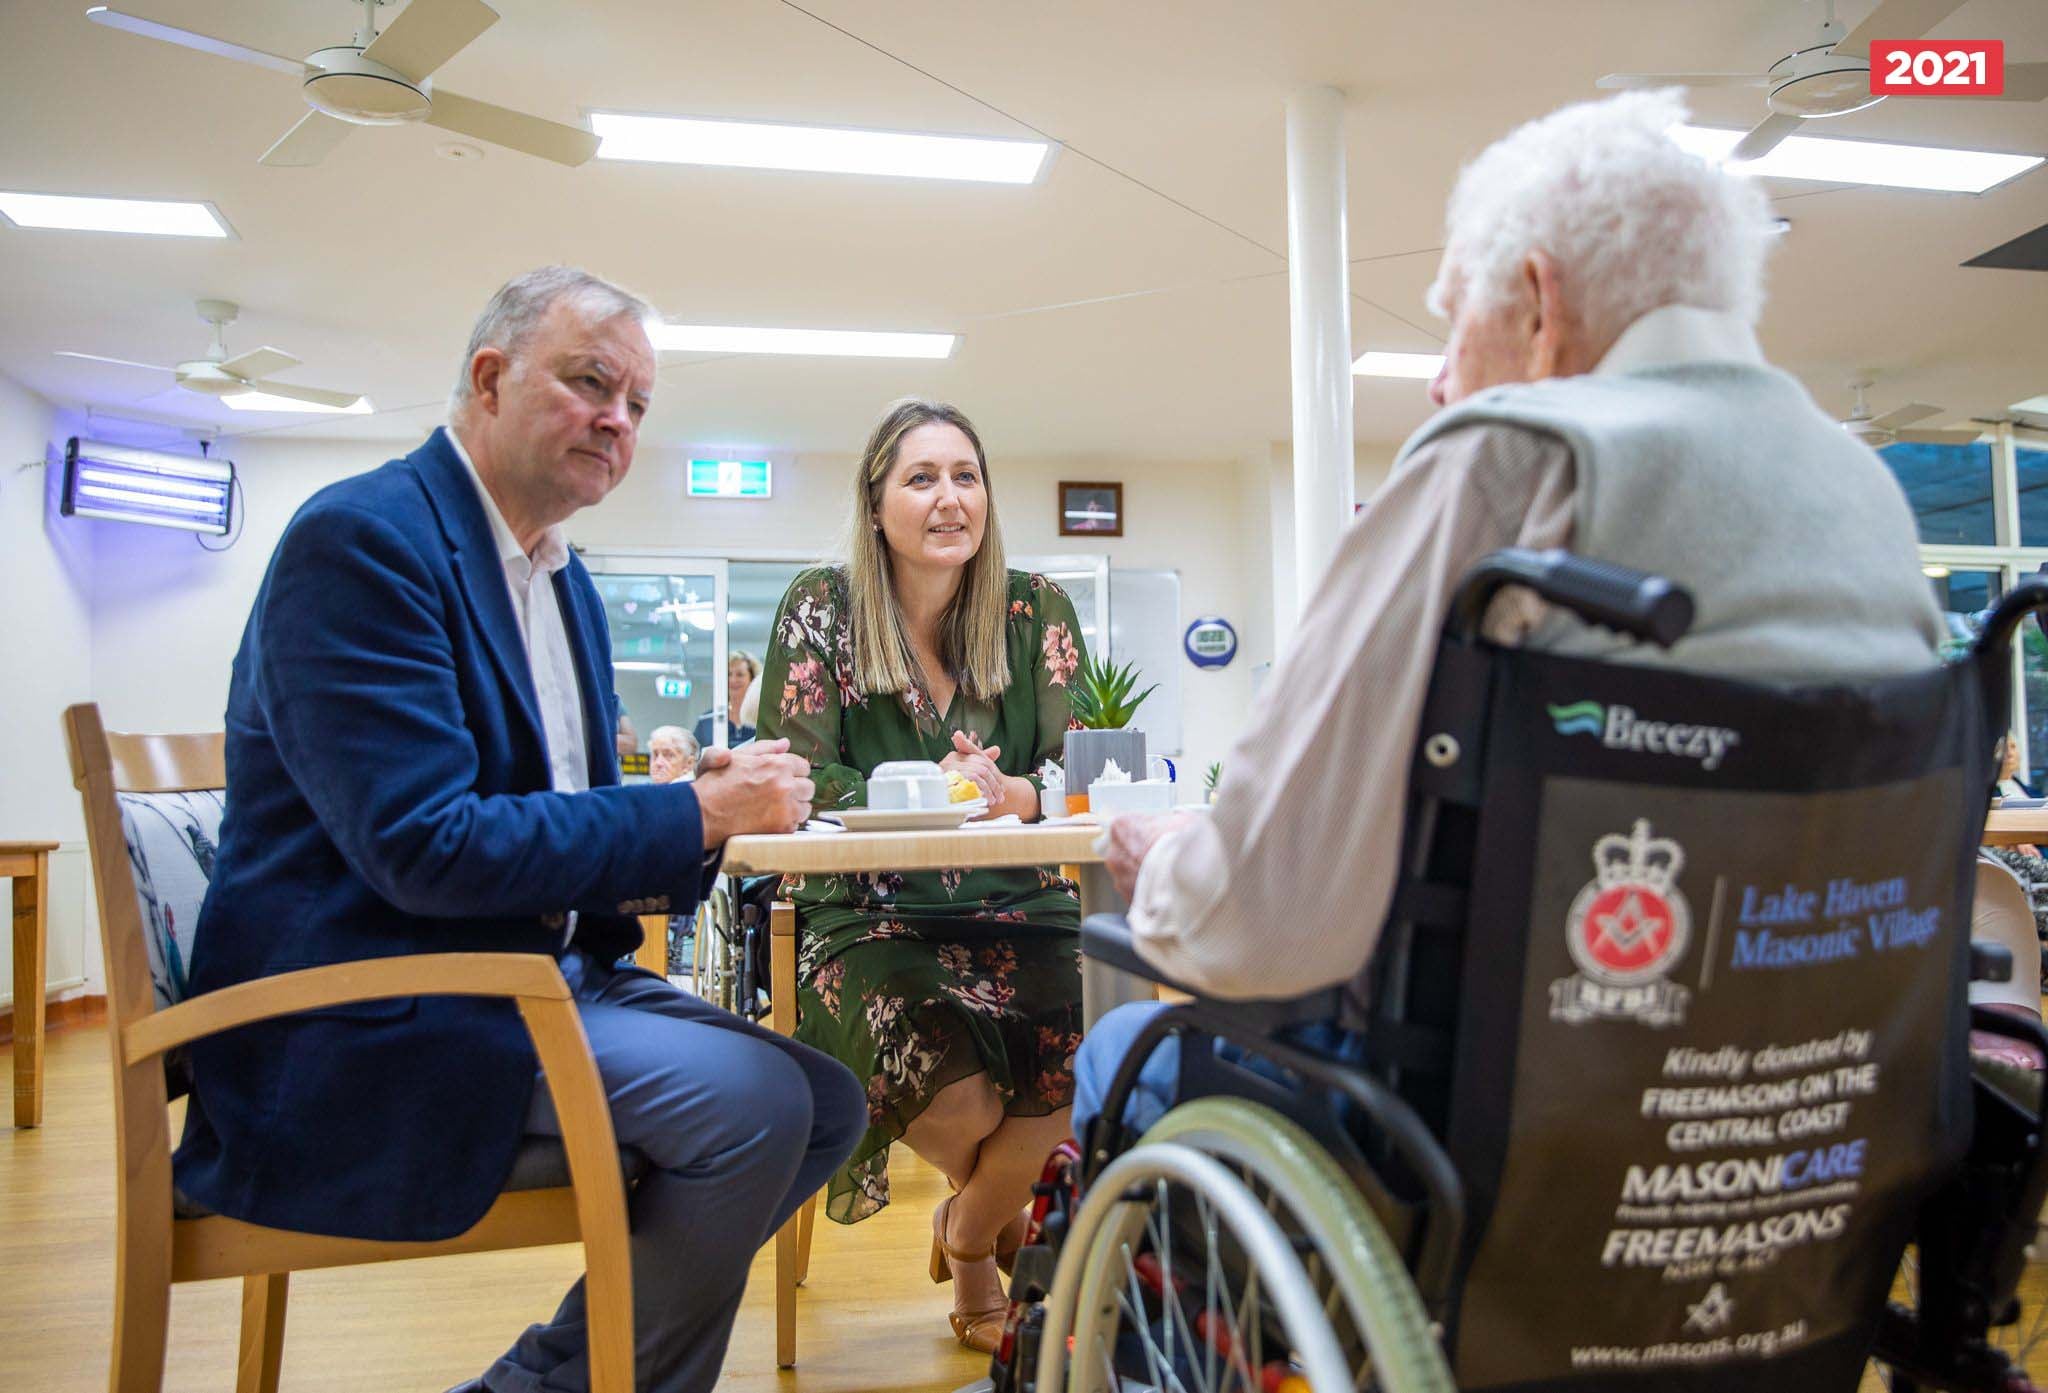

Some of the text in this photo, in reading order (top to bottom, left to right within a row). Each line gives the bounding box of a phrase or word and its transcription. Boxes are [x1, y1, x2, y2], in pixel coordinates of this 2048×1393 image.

[1739, 877, 1905, 925] Lake Haven
[1731, 907, 1940, 968] Masonic Village
[1662, 1029, 1872, 1080] Kindly donated by
[1640, 1063, 1879, 1119] FREEMASONS ON THE
[1666, 1102, 1850, 1151] CENTRAL COAST
[1622, 1139, 1868, 1201] MASONICARE
[1600, 1204, 1852, 1268] FREEMASONS
[1571, 1320, 1808, 1368] www.masons.org.au
